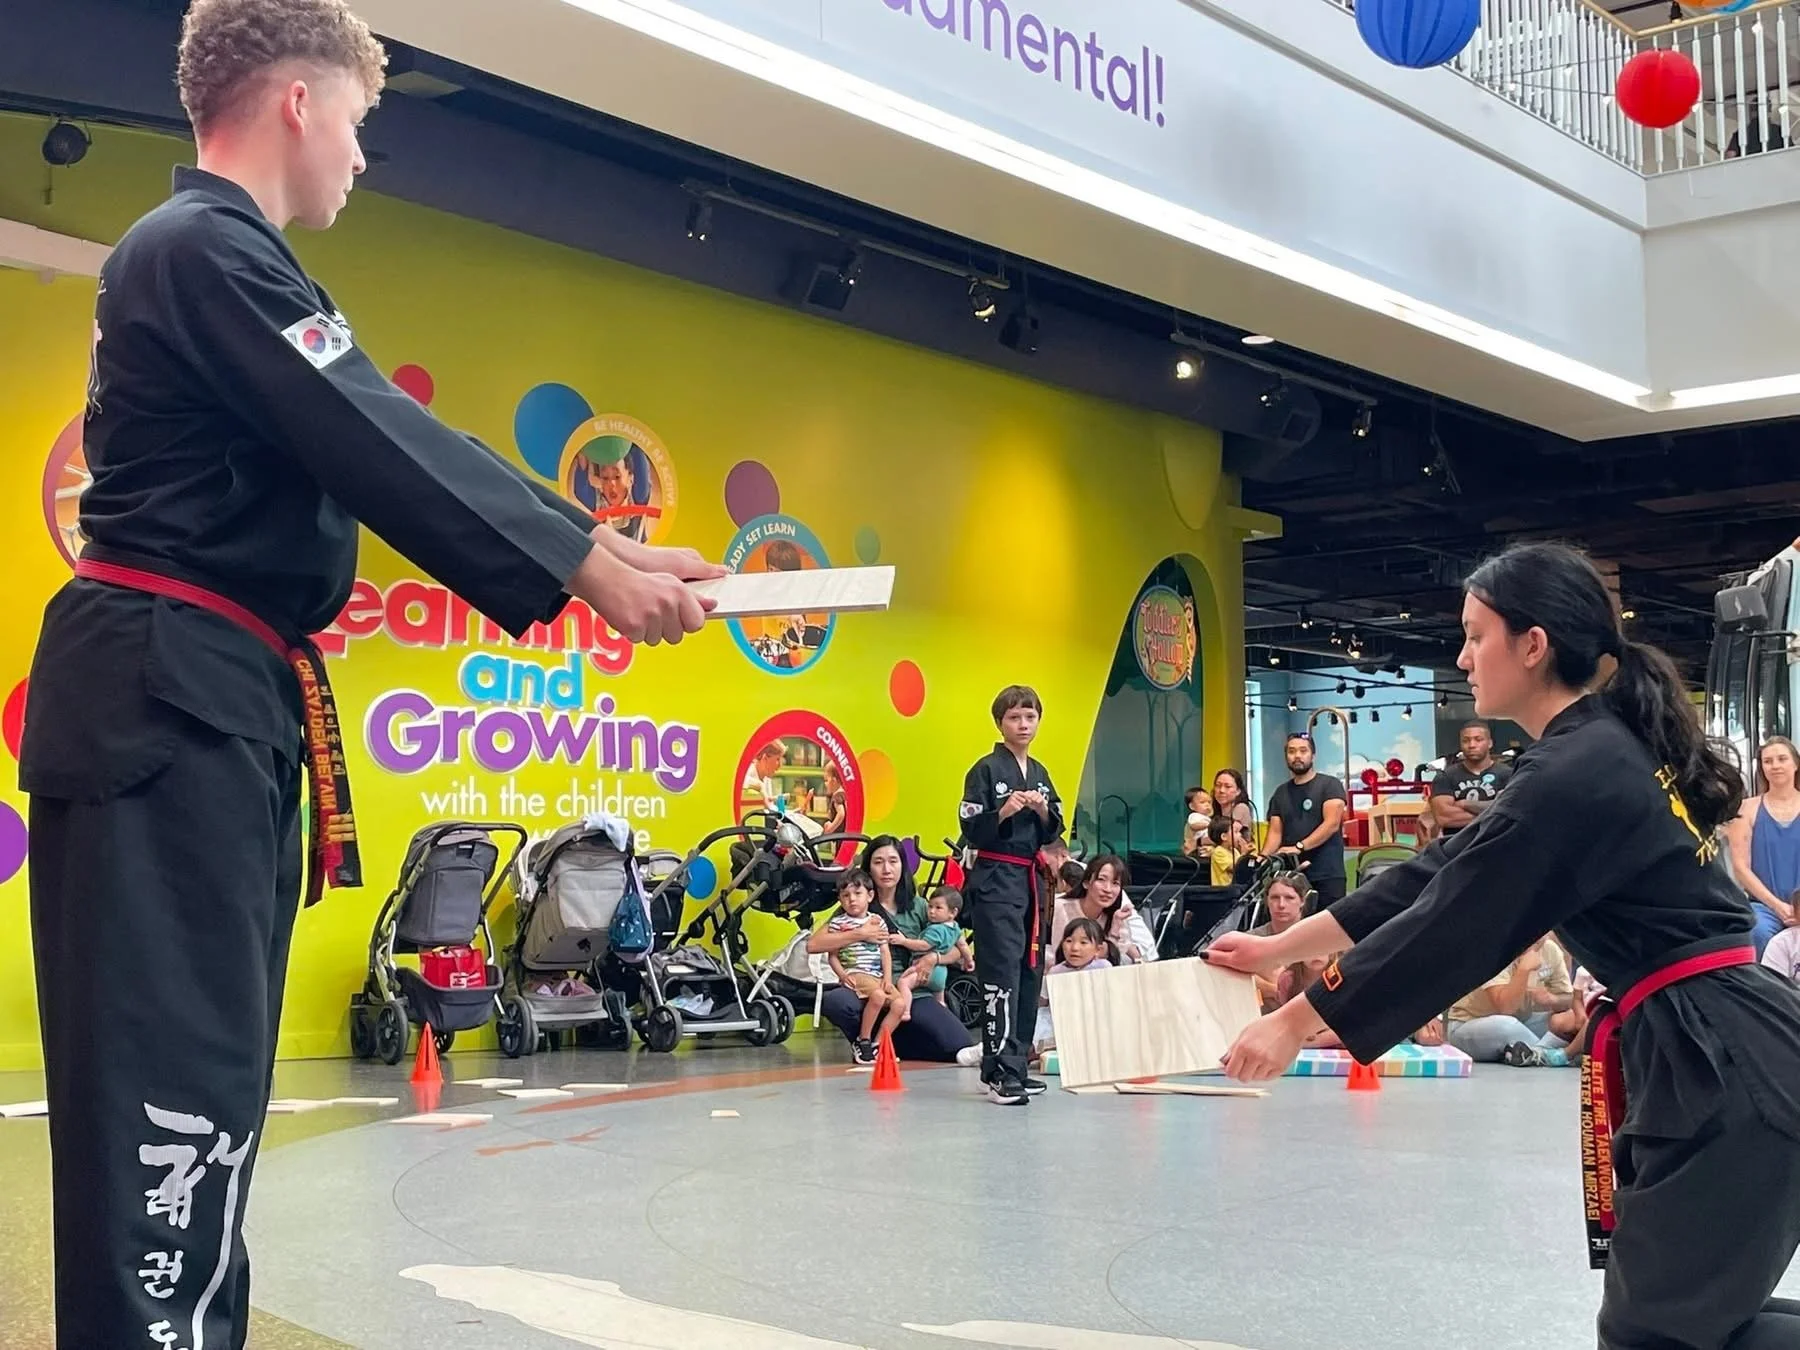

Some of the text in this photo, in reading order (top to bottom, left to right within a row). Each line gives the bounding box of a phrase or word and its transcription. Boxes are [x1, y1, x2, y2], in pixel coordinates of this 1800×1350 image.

[880, 0, 1165, 128] amental!
[609, 421, 653, 448] HEALTHY
[728, 522, 796, 574] EADY SET LEARN
[459, 652, 584, 710] and
[366, 692, 701, 793] Growing
[816, 726, 855, 782] CONNECT
[421, 775, 666, 818] with the children
[1581, 1053, 1600, 1221] MASTER HOUMAN MIRZAEI
[1592, 1061, 1614, 1213] ELITE FIRE TAEKWONDO
